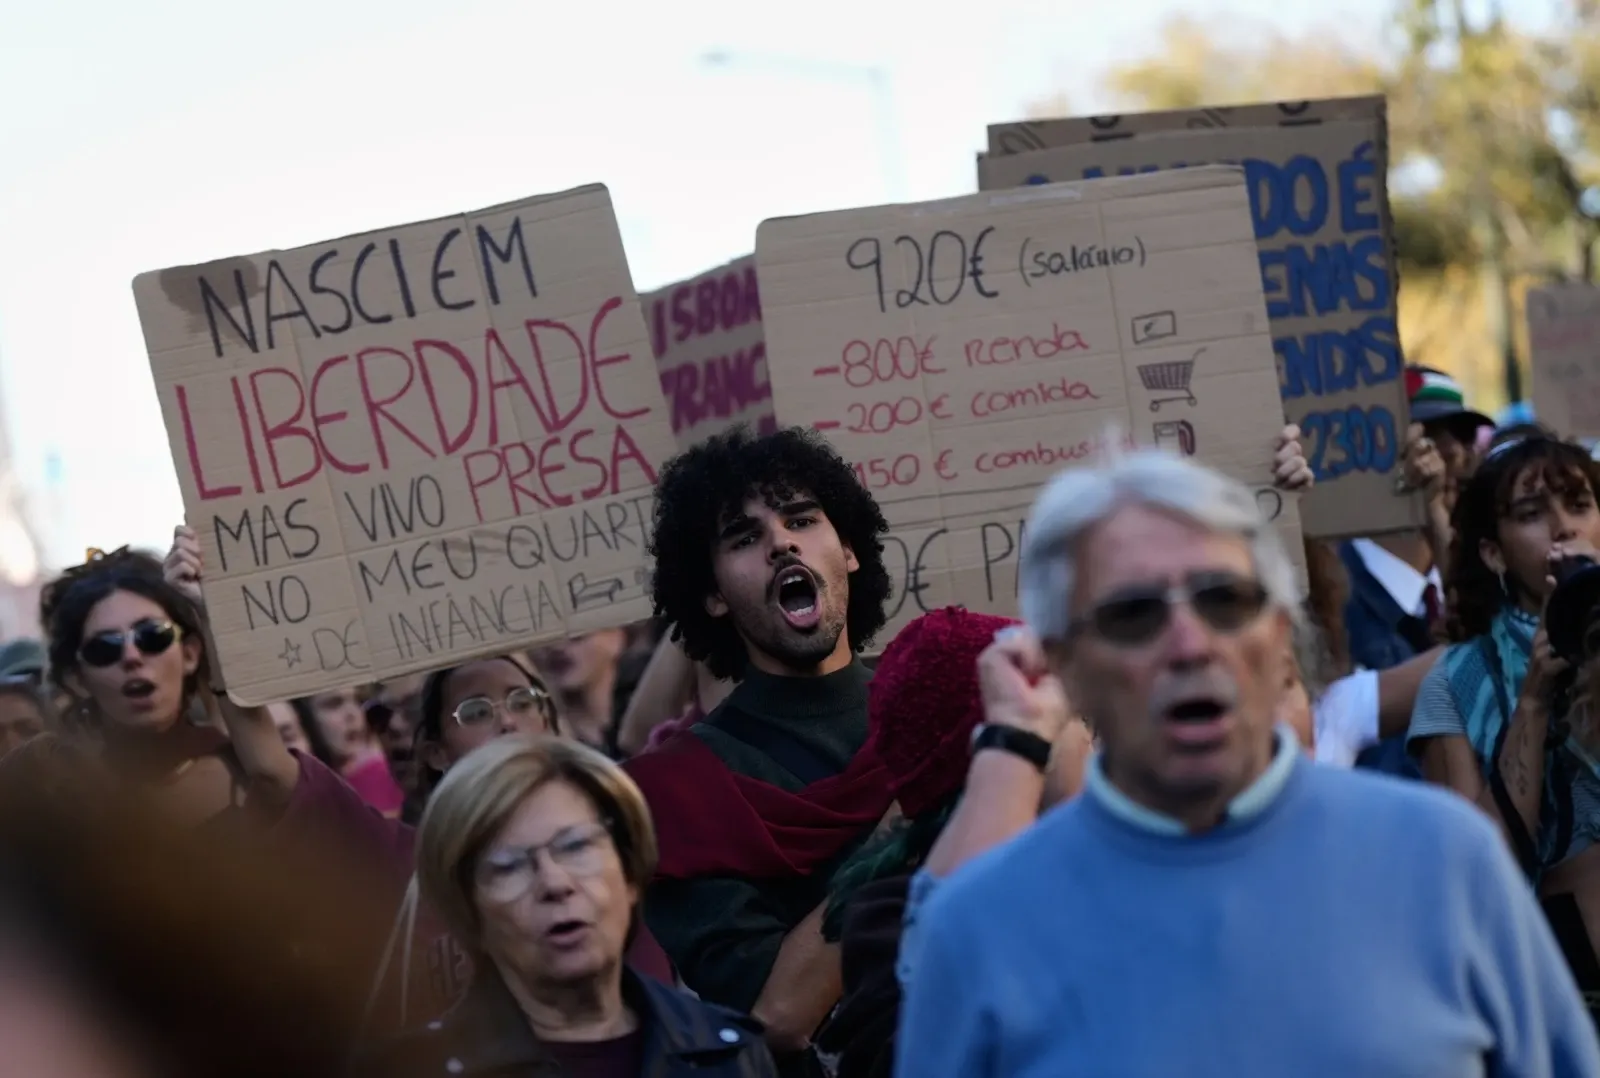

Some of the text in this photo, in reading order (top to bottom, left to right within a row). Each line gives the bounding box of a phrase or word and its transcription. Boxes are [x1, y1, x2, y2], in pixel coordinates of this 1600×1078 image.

[1337, 139, 1379, 233] É
[846, 226, 999, 313] 920€
[1257, 234, 1390, 320] ENAS
[175, 297, 651, 500] LIBERDADE
[971, 376, 1103, 417] comida
[1300, 405, 1398, 482] 2300
[213, 424, 659, 572] MAS VIVO PRESA
[240, 493, 660, 631] NO MEU QUART
[311, 618, 371, 671] DE
